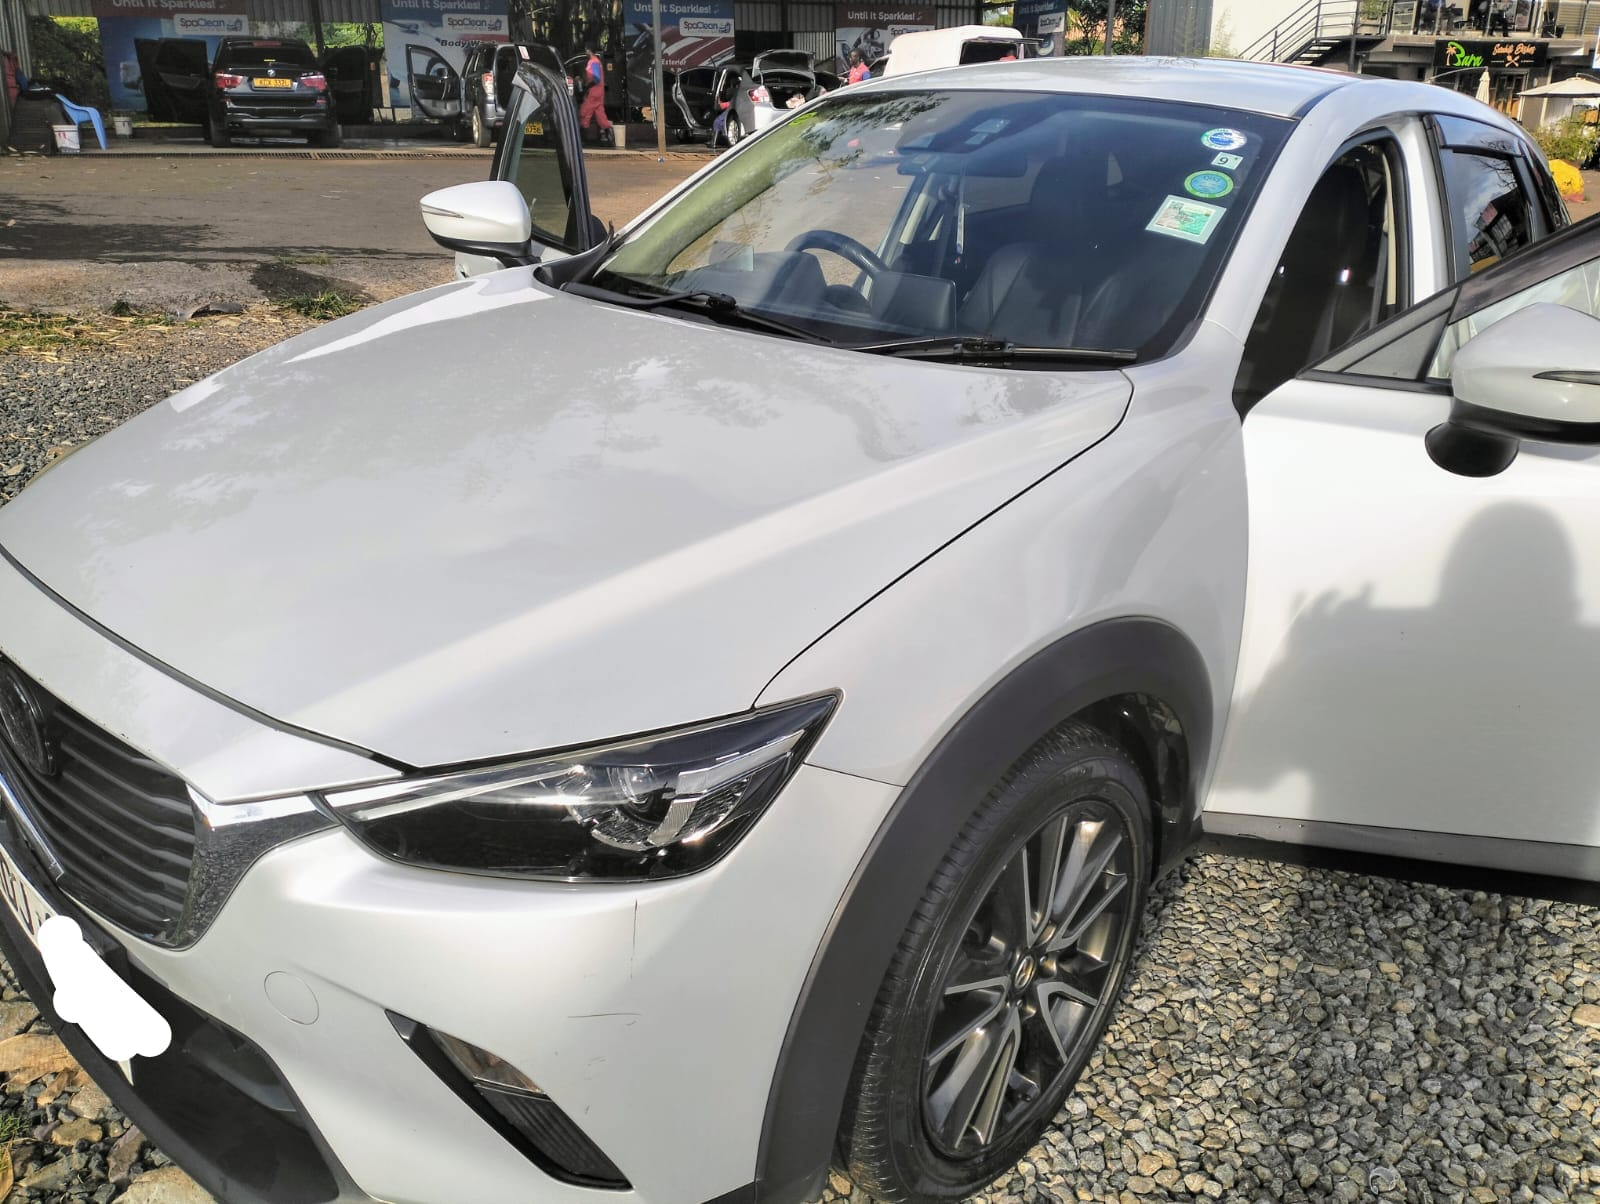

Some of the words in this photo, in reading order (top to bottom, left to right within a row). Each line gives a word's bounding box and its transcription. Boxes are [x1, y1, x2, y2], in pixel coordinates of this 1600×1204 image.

[392, 0, 419, 9] Until
[433, 1, 480, 11] Sparkles!
[669, 4, 712, 15] Sparkles!
[847, 11, 869, 20] Until
[870, 11, 877, 20] It
[878, 12, 915, 22] Sparkles!
[179, 17, 226, 29] SpaClean
[447, 17, 487, 28] SpaClean
[683, 21, 718, 31] SpaClean
[440, 39, 467, 49] Body
